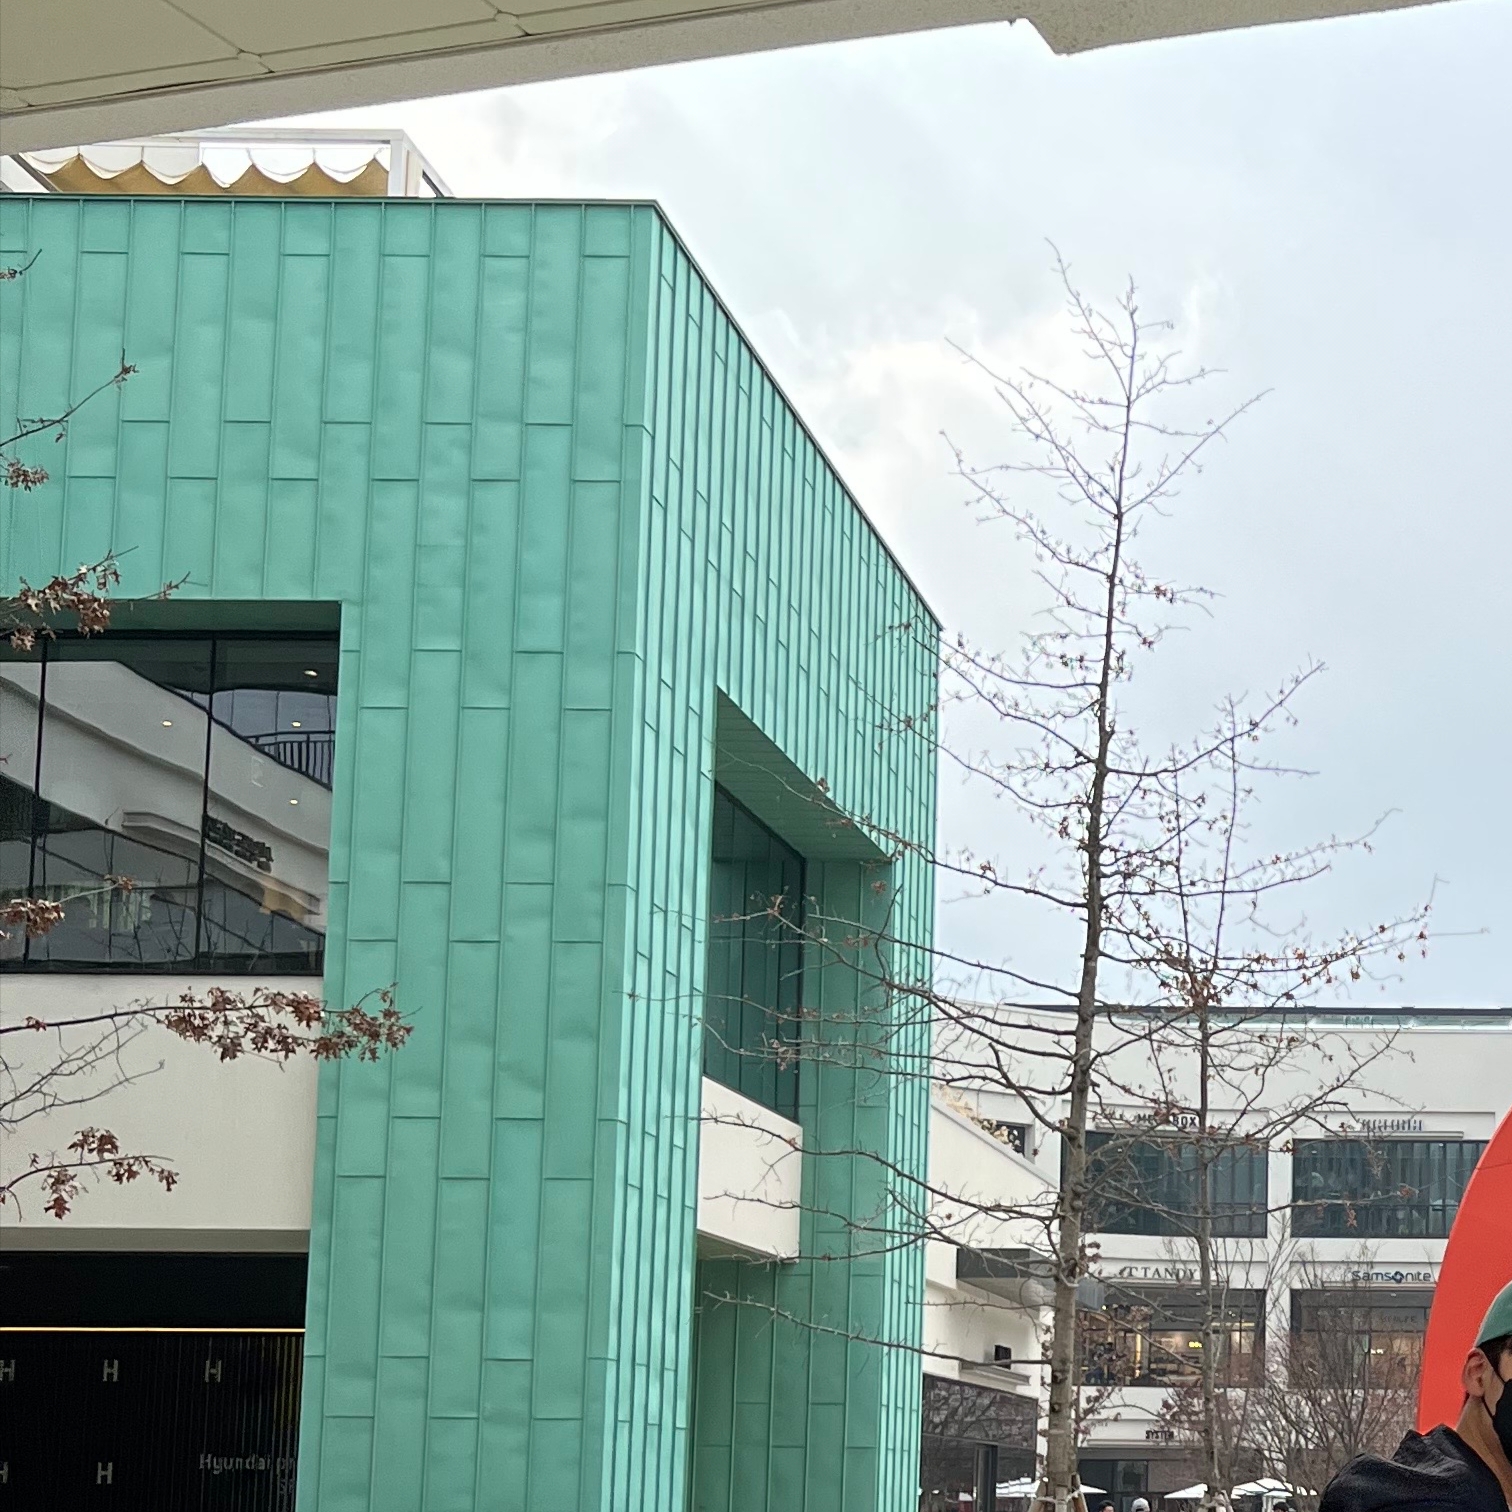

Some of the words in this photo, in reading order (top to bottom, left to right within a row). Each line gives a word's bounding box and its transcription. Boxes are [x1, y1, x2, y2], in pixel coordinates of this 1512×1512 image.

[1351, 1270, 1432, 1283] Samsonite
[103, 1359, 118, 1382] H
[205, 1360, 221, 1383] H
[97, 1462, 113, 1484] H
[199, 1453, 271, 1475] Hyundai
